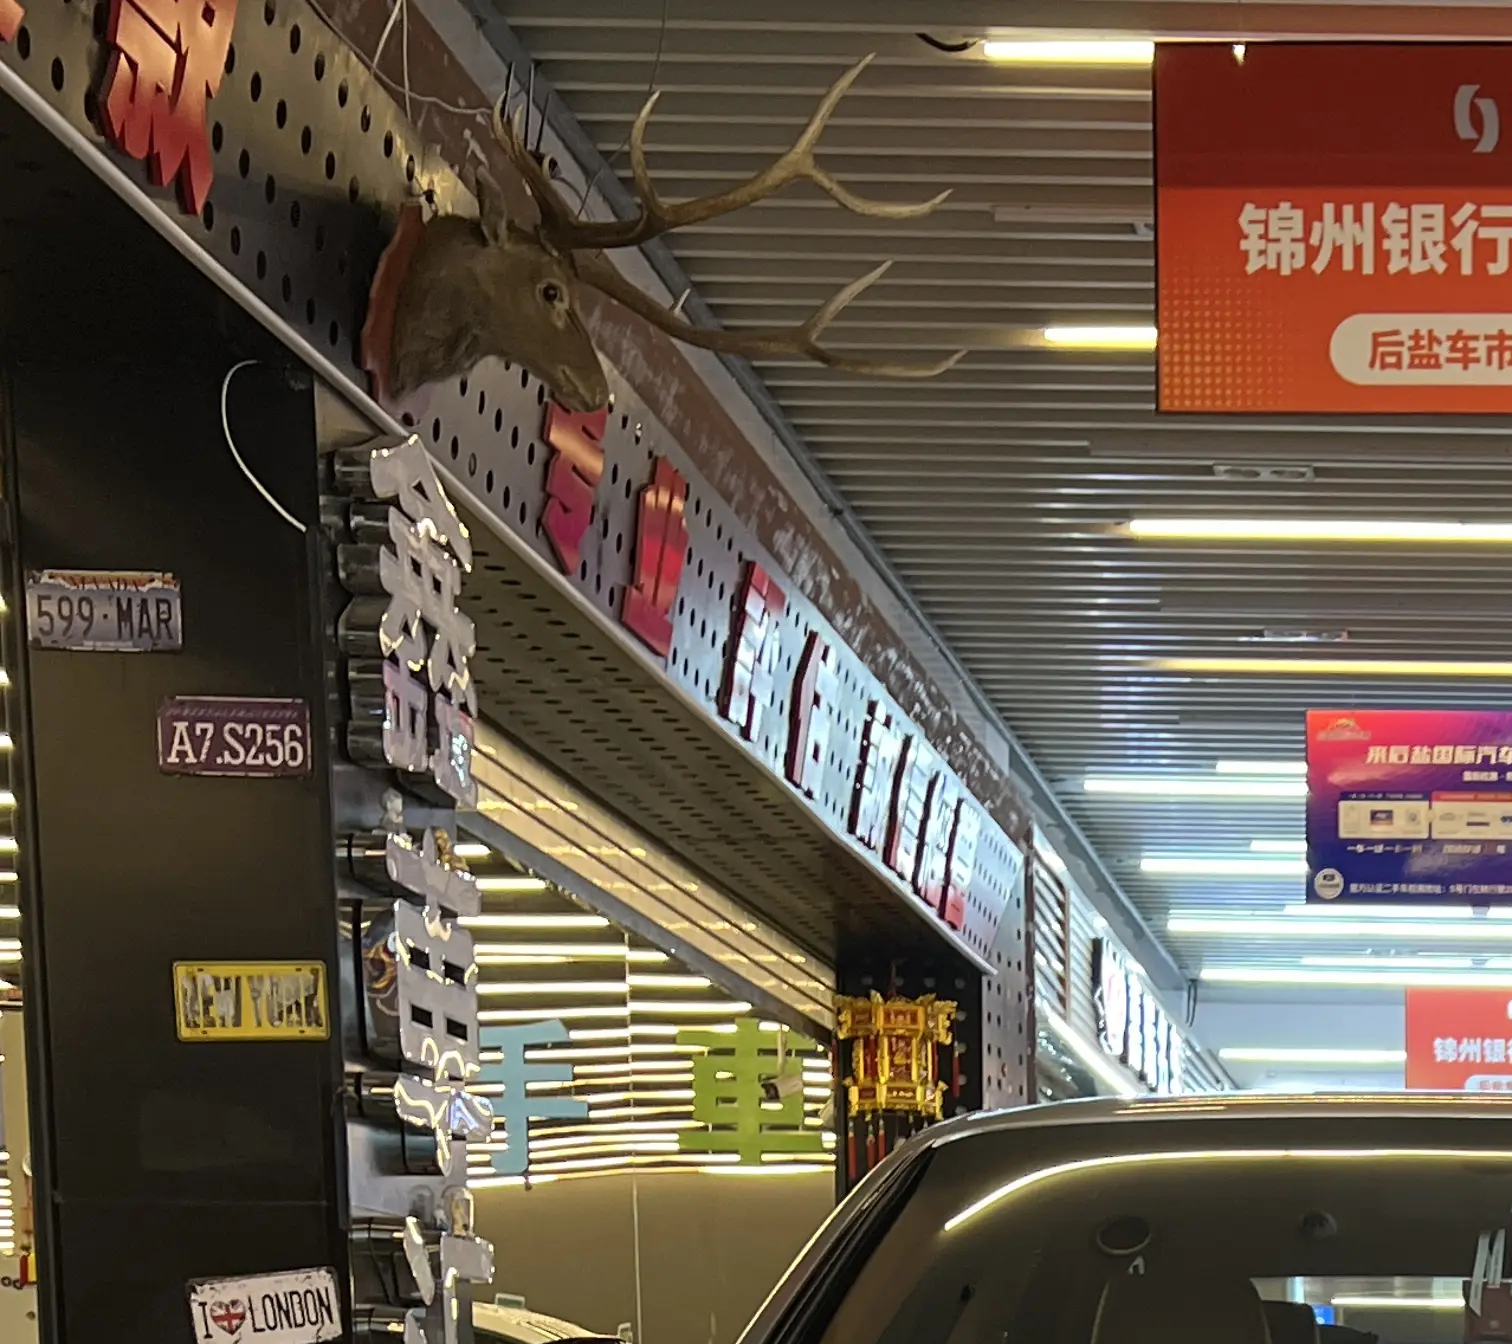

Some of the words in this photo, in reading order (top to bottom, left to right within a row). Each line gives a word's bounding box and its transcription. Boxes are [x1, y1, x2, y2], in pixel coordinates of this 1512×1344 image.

[167, 721, 304, 767] A7.S256
[198, 1301, 213, 1339] I
[247, 1286, 334, 1333] LONDON
